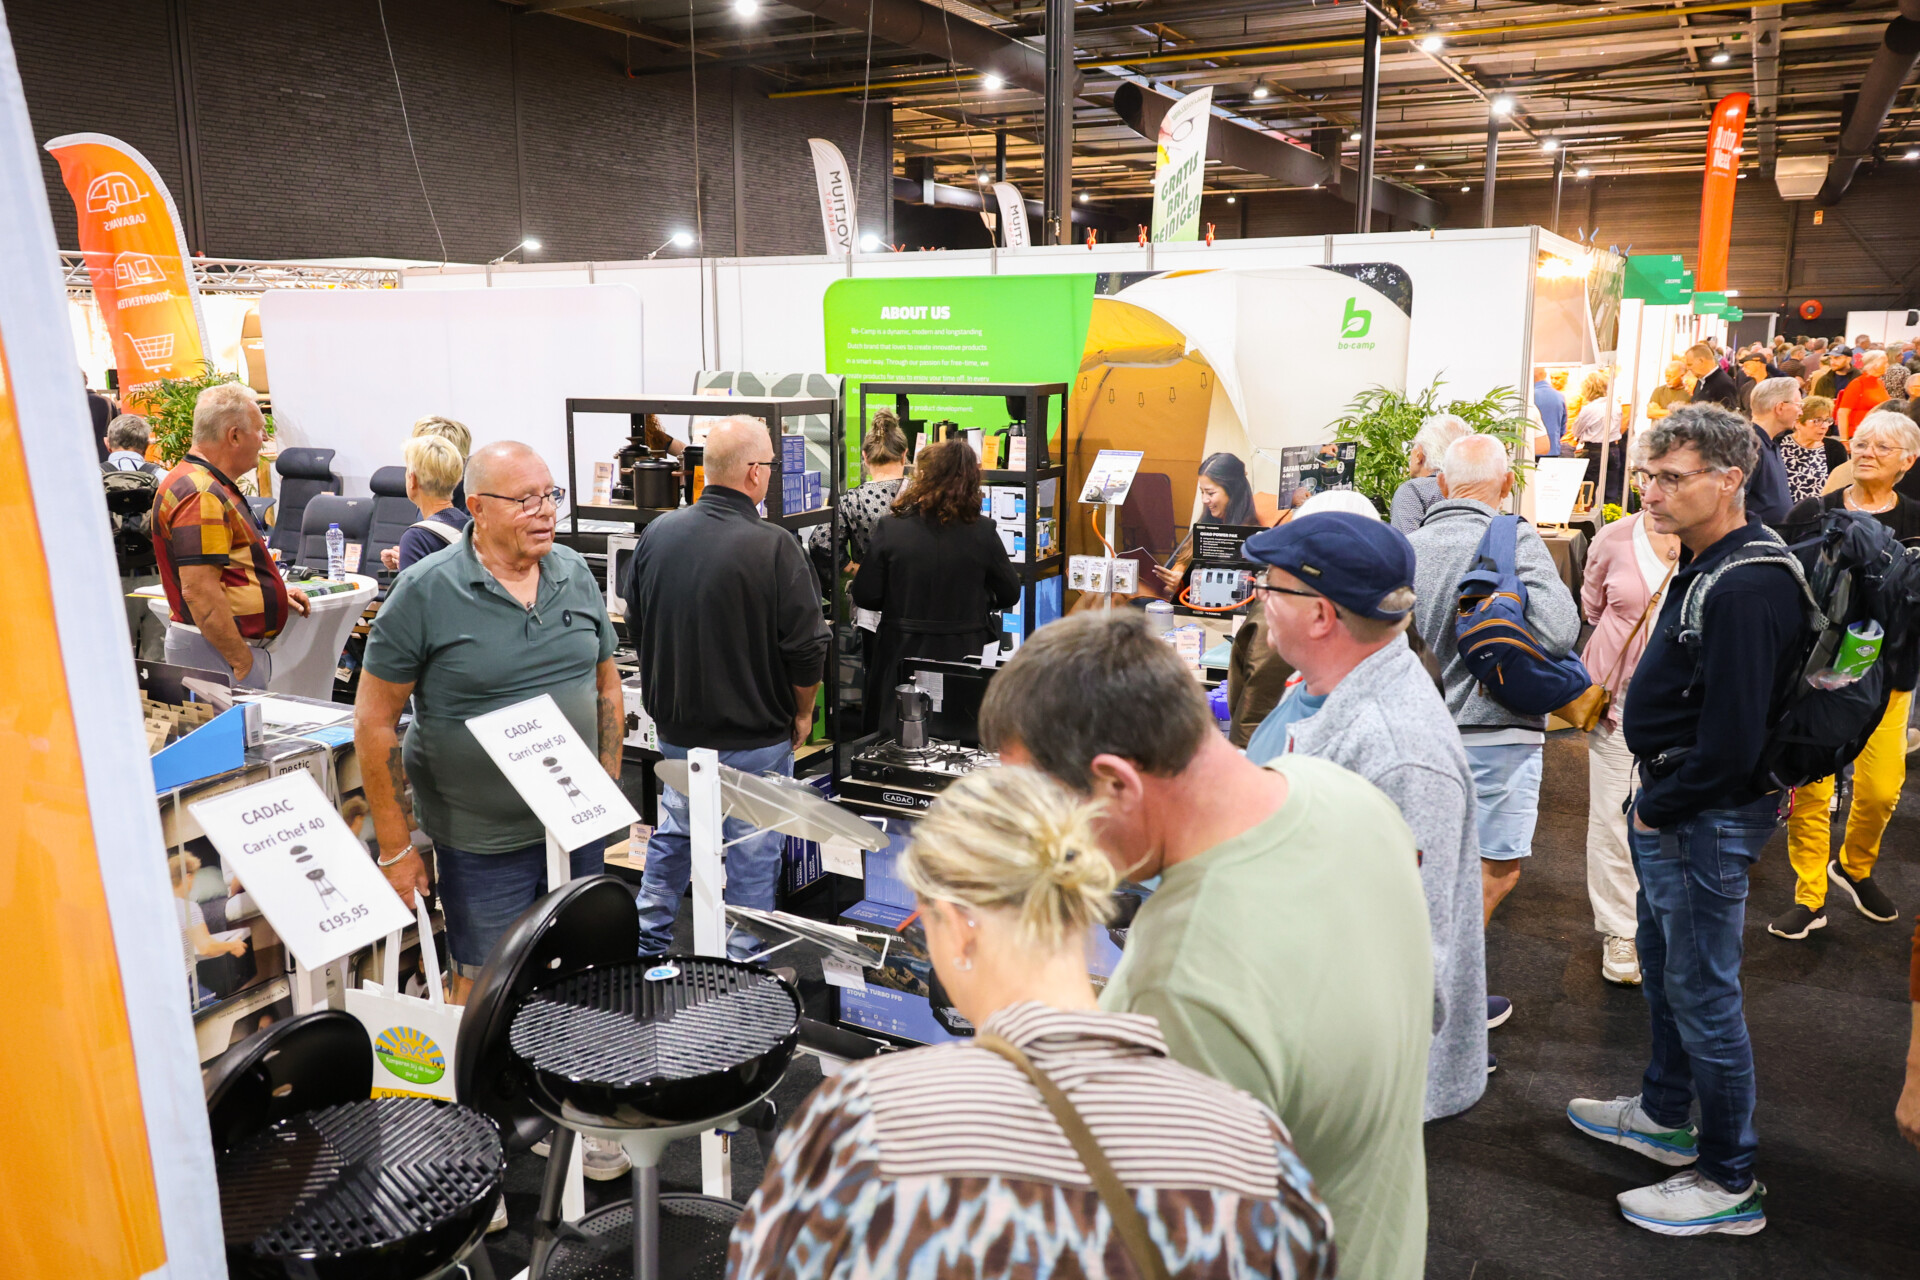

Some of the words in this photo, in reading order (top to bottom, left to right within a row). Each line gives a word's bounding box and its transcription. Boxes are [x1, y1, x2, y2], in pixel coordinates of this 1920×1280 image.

[1712, 126, 1737, 150] Auto
[1161, 151, 1199, 201] GRATIS
[1166, 183, 1189, 218] BRIL
[880, 306, 928, 320] ABOUT
[931, 306, 950, 320] US
[504, 719, 543, 740] CADAC
[508, 745, 534, 763] Carri
[534, 738, 554, 756] Chef
[554, 734, 566, 746] 50
[279, 760, 310, 774] mestic
[886, 794, 912, 804] CADAC
[241, 799, 294, 826] CADAC
[571, 804, 607, 825] €239,95
[243, 833, 278, 855] Carri
[280, 823, 308, 845] Chef
[308, 816, 325, 834] 40
[319, 904, 369, 934] €195,95
[847, 989, 866, 998] STOVE
[870, 989, 890, 998] TURBO
